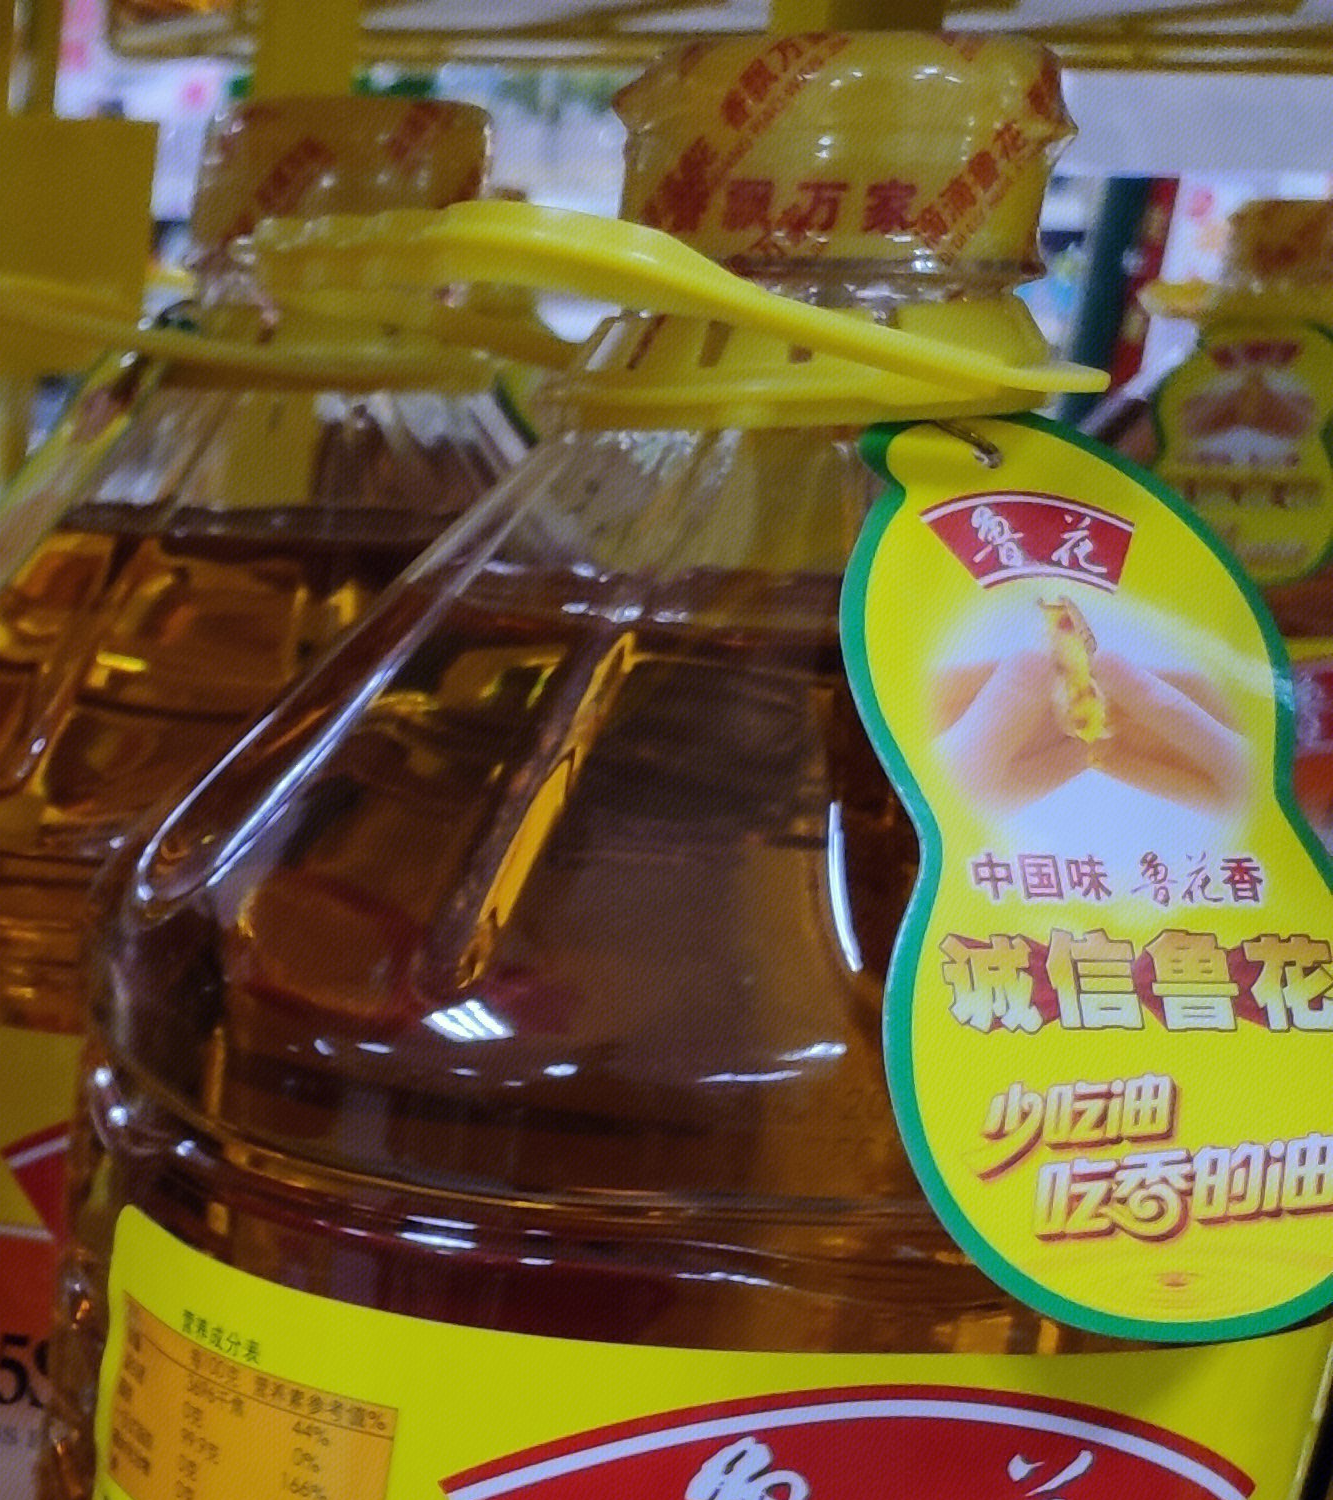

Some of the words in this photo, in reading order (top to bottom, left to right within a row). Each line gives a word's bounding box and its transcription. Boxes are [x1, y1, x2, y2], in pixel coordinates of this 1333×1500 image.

[971, 504, 1107, 573] 鲁花
[972, 851, 1112, 900] 中国味
[1132, 850, 1264, 906] 鲁花香
[939, 928, 1333, 1034] 诚信鲁花
[975, 1073, 1181, 1180] 少吃油
[1035, 1132, 1333, 1243] 吃香的油
